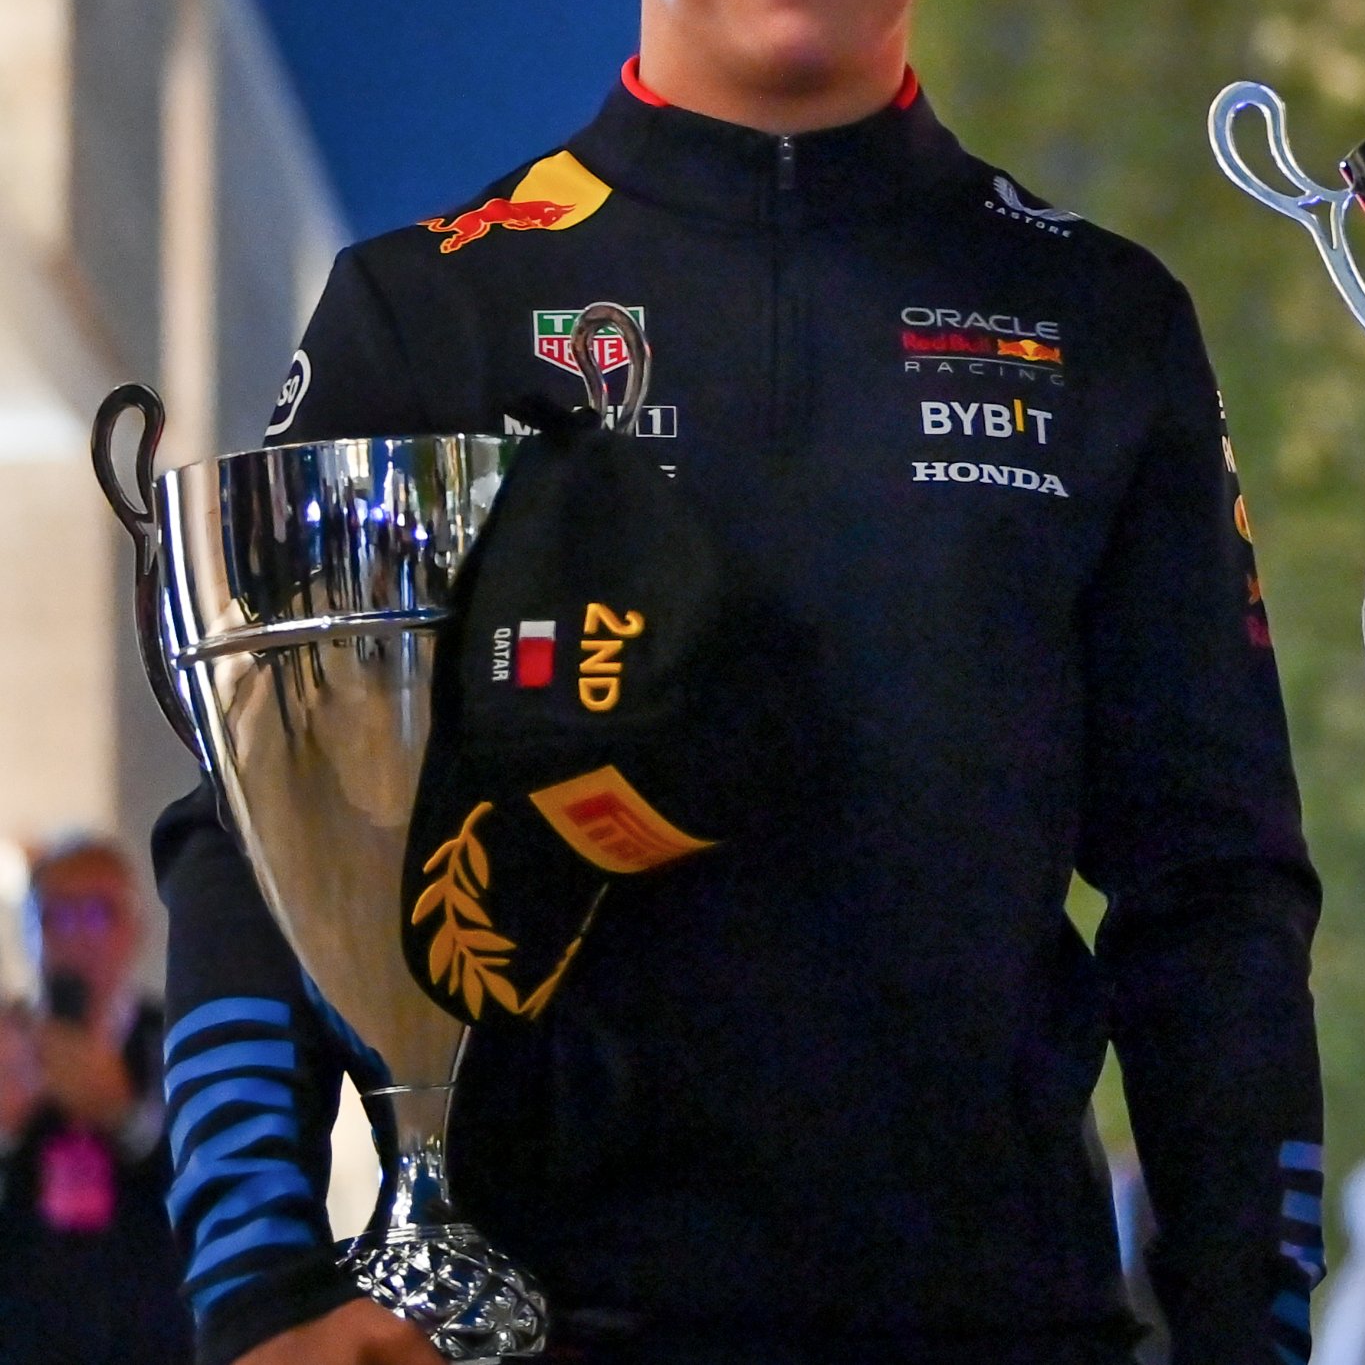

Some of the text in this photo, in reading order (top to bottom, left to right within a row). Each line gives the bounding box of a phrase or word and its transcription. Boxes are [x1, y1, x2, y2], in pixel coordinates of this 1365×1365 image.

[984, 200, 1072, 238] CASTORE
[900, 307, 1061, 340] ORACLE
[904, 361, 1065, 387] RACING
[920, 398, 1053, 445] BYBIT
[911, 461, 1071, 498] HONDA
[491, 627, 512, 683] QATAR
[577, 602, 646, 712] 2ND
